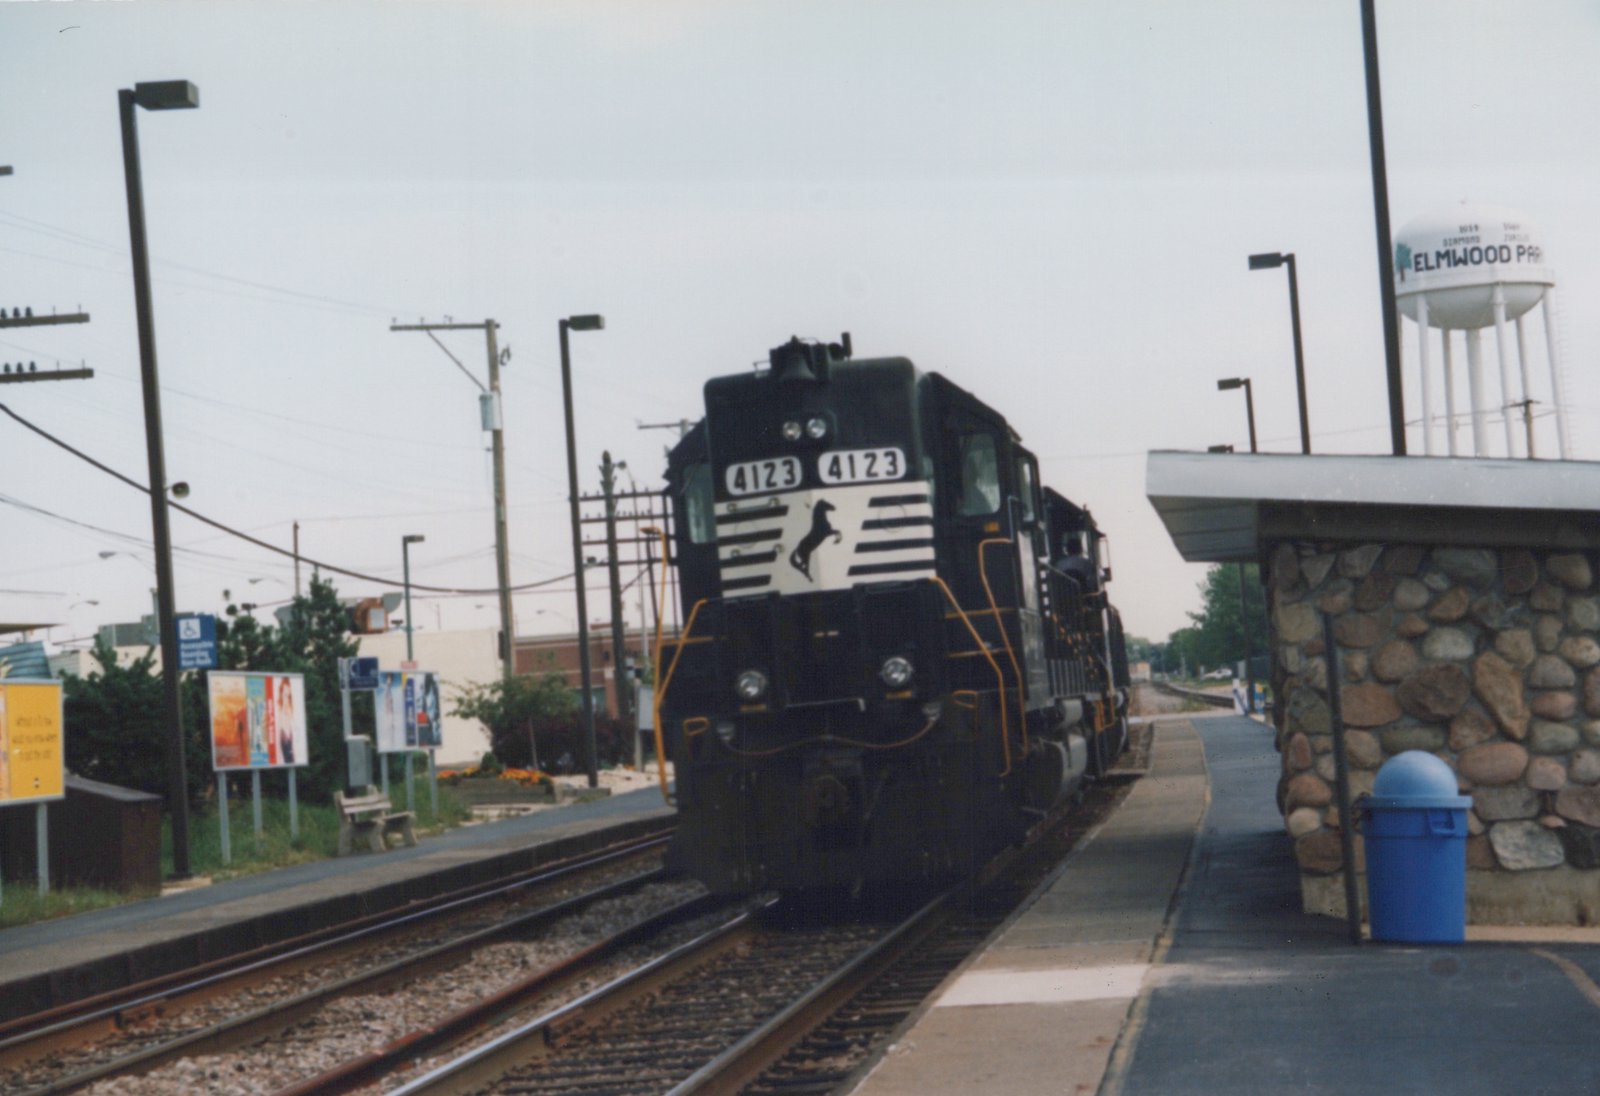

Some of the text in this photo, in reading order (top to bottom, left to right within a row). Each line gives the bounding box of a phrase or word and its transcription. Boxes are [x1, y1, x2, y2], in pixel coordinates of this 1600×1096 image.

[1414, 245, 1511, 273] ELMWOOD
[733, 458, 796, 492] 4123
[828, 450, 898, 480] 4123
